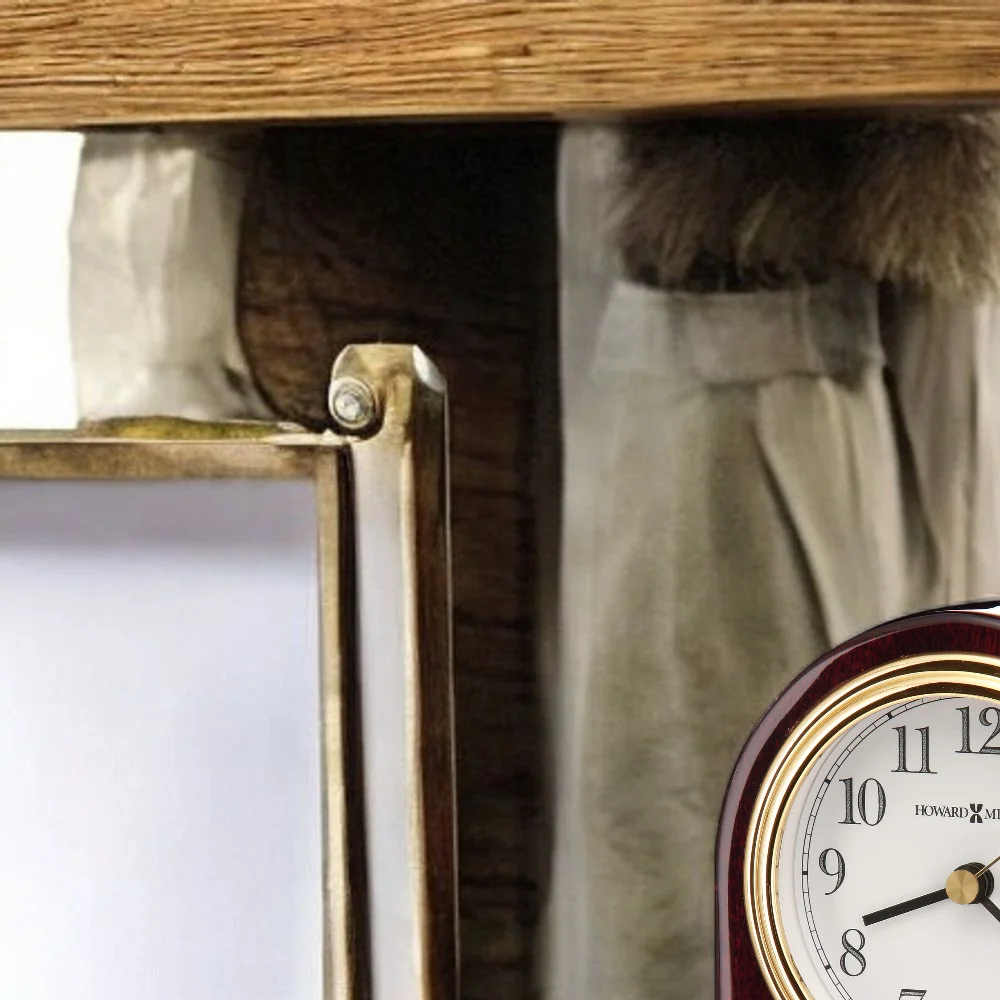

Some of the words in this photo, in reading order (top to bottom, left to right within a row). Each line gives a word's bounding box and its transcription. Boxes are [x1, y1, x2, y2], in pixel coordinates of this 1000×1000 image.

[890, 724, 938, 775] 11
[837, 776, 887, 827] 10
[914, 803, 969, 819] HOWARD
[818, 847, 846, 896] 9
[839, 928, 867, 977] 8
